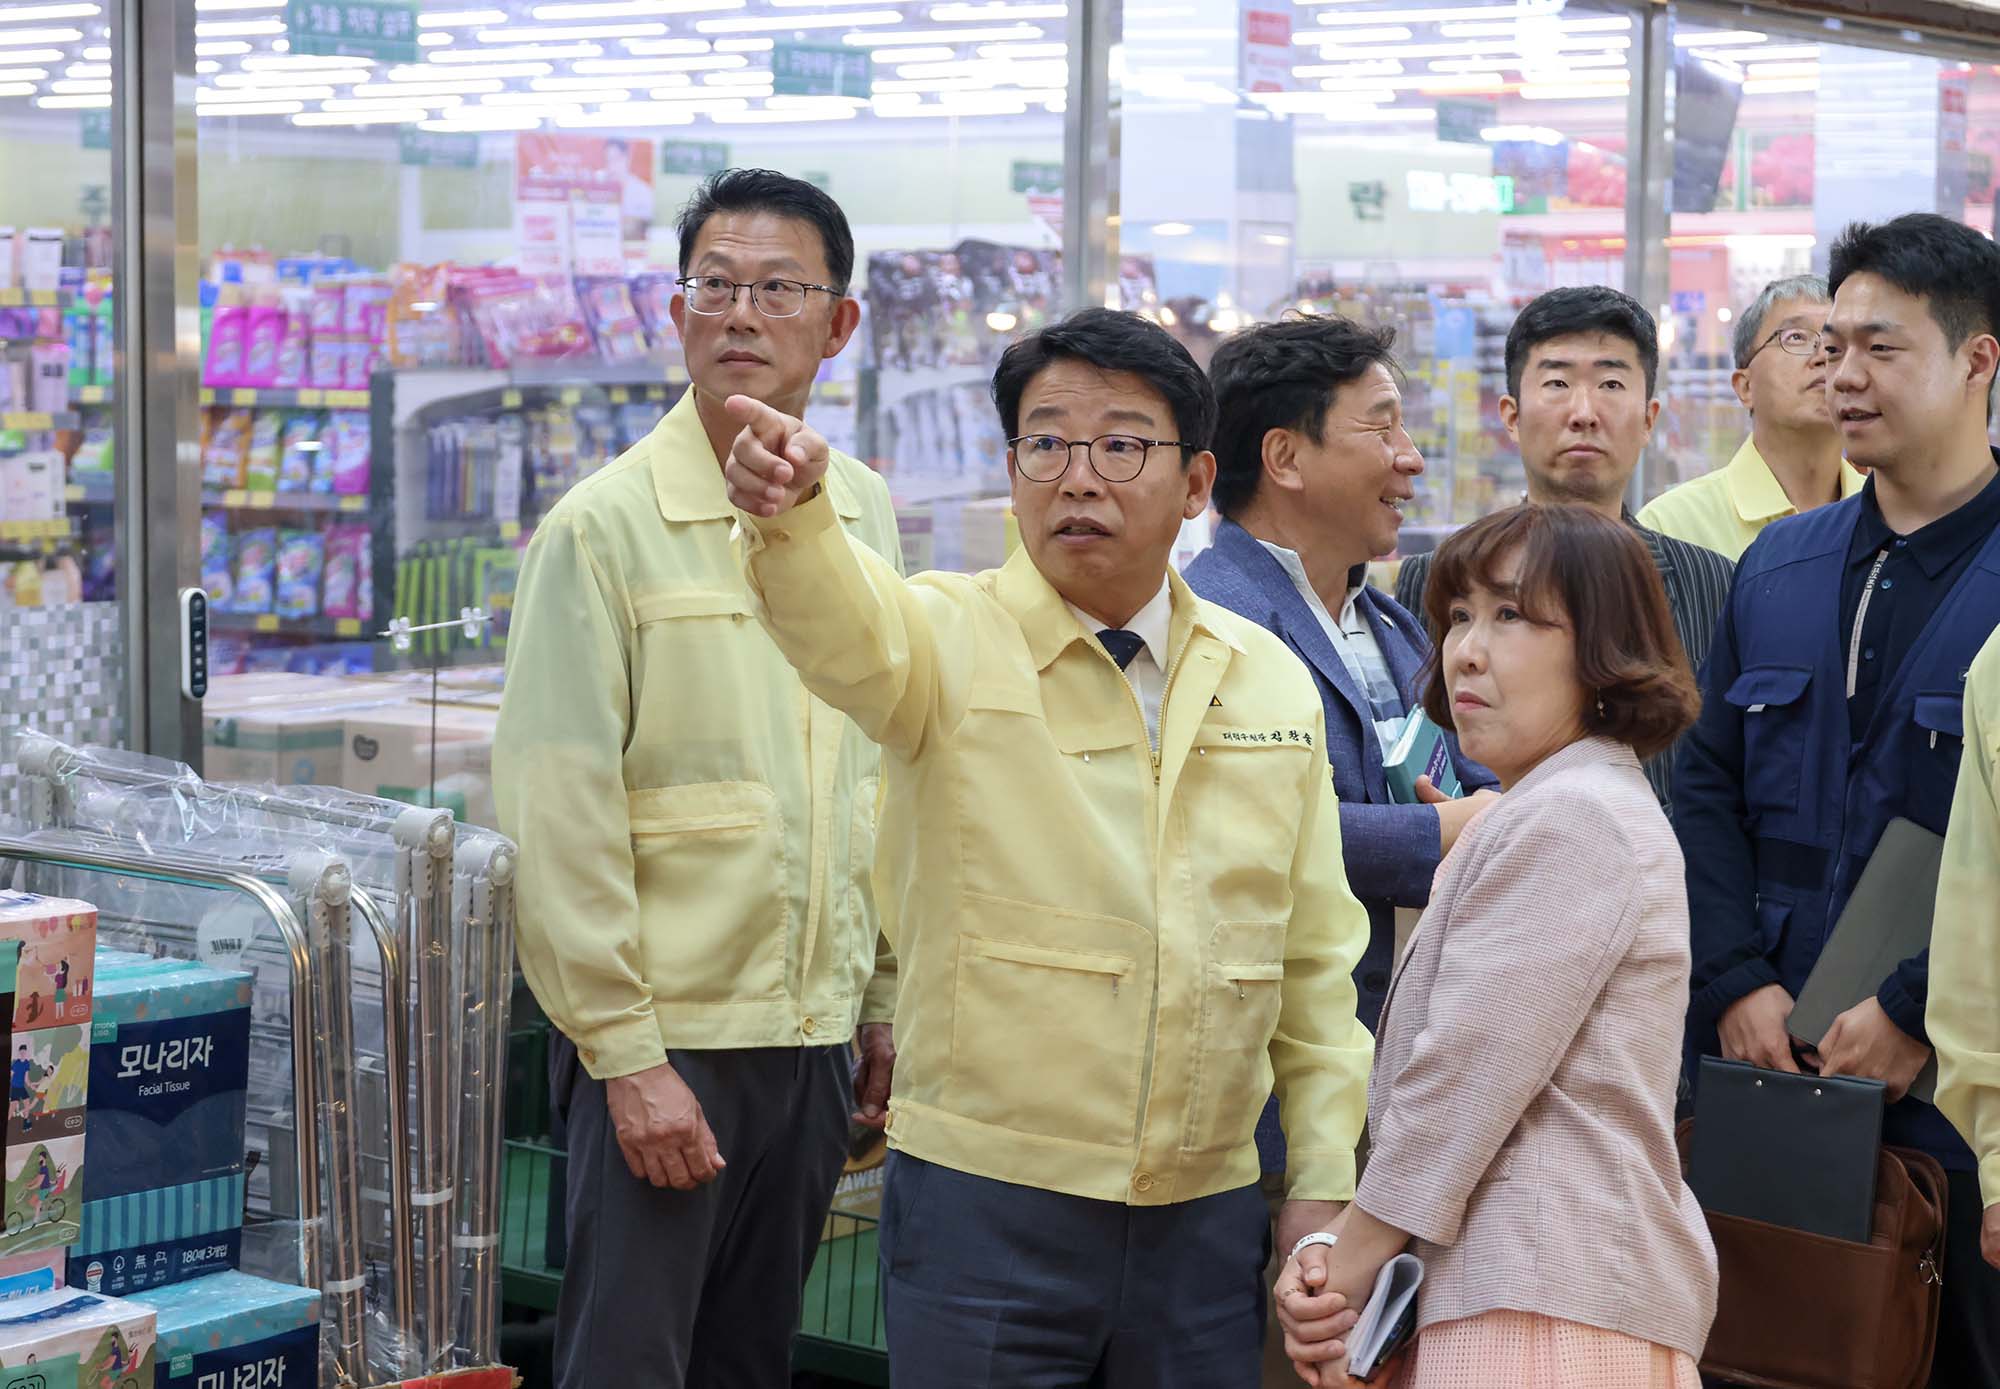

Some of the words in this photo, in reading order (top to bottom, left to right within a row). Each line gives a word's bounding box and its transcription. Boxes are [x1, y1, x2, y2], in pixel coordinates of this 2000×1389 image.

[117, 1035, 214, 1078] 모나리자
[138, 1082, 163, 1097] Facial
[165, 1080, 190, 1093] Tissue
